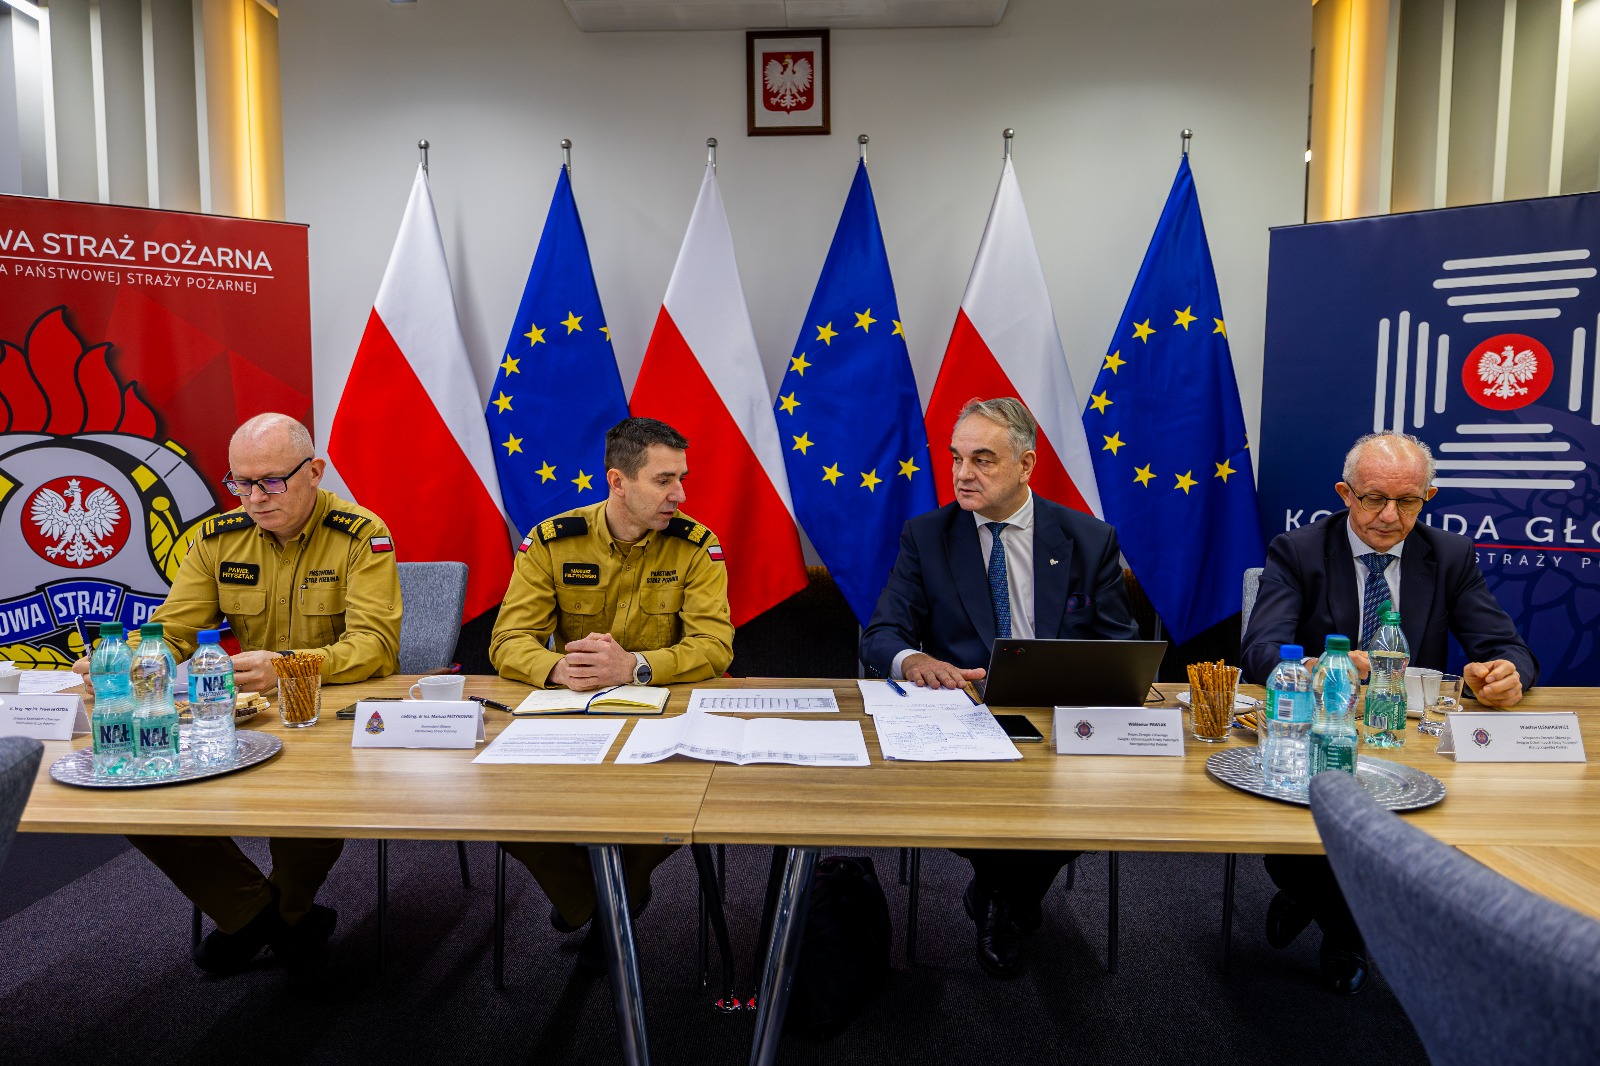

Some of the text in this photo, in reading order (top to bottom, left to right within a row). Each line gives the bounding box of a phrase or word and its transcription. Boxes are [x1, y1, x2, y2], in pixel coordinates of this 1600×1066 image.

[42, 233, 136, 261] STRAŻ
[143, 239, 273, 272] POŻARNA
[15, 263, 121, 285] PAŃSTWOWEJ
[127, 272, 181, 288] STRAŻY
[187, 276, 257, 294] POŻARNEJ
[53, 589, 117, 618] STRAŻ
